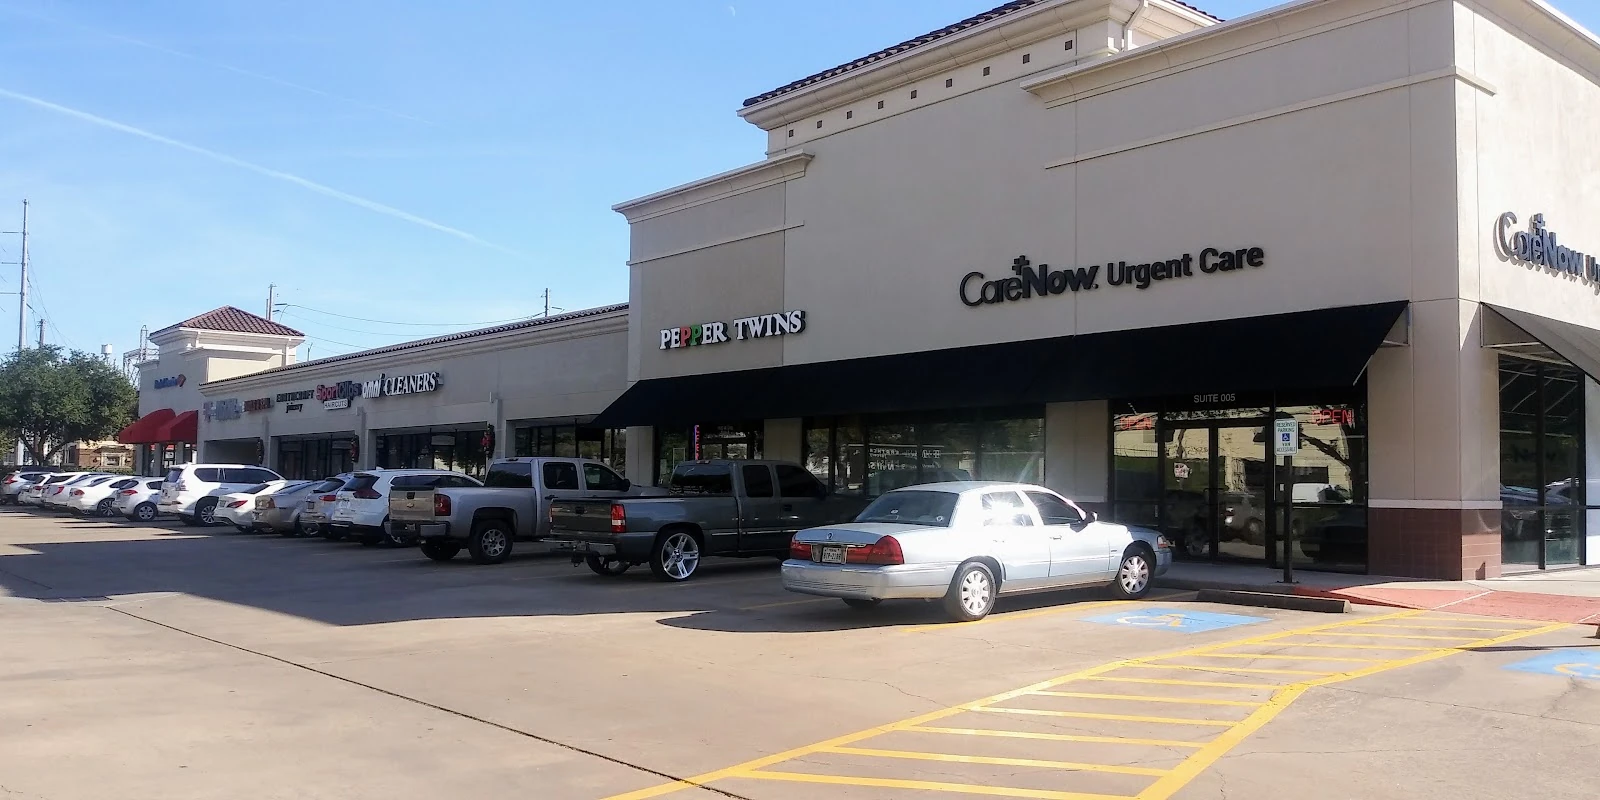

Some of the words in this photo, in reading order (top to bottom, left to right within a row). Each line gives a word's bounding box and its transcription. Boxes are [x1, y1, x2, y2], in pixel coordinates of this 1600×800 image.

[1494, 211, 1584, 278] CareNow
[959, 262, 1099, 307] CareNow
[1106, 253, 1193, 289] Urgent
[1199, 246, 1265, 274] Care
[659, 321, 731, 350] PEPPER
[733, 309, 806, 341] TWINS
[385, 371, 437, 396] CLEANERS
[323, 399, 348, 410] HAIRCUTS
[1193, 394, 1219, 403] SUITE
[1220, 393, 1236, 402] 005
[1312, 409, 1353, 425] OPEN
